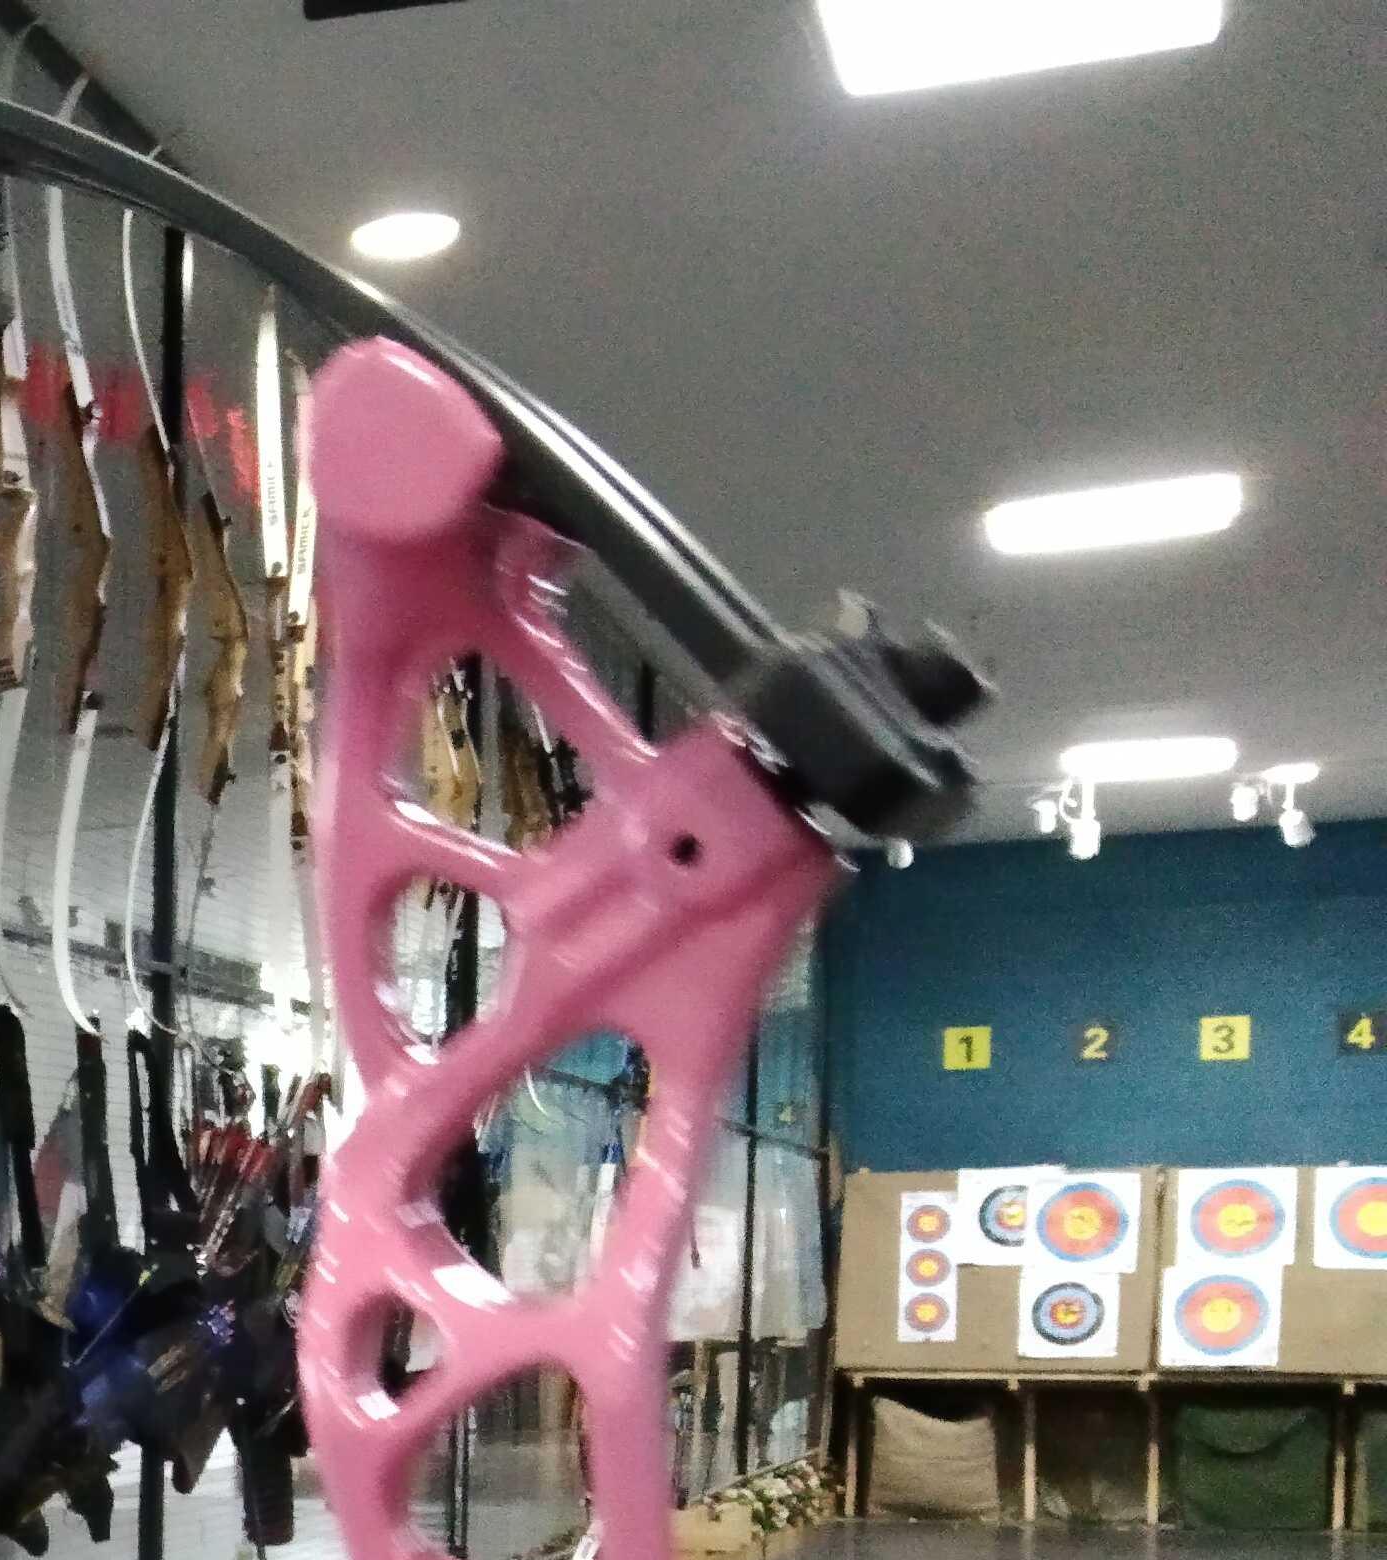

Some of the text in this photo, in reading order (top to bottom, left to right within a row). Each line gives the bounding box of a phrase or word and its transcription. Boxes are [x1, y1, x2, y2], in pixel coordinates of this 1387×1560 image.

[1082, 1026, 1108, 1060] 2
[1213, 1024, 1235, 1054] 3
[1347, 1016, 1376, 1050] 4
